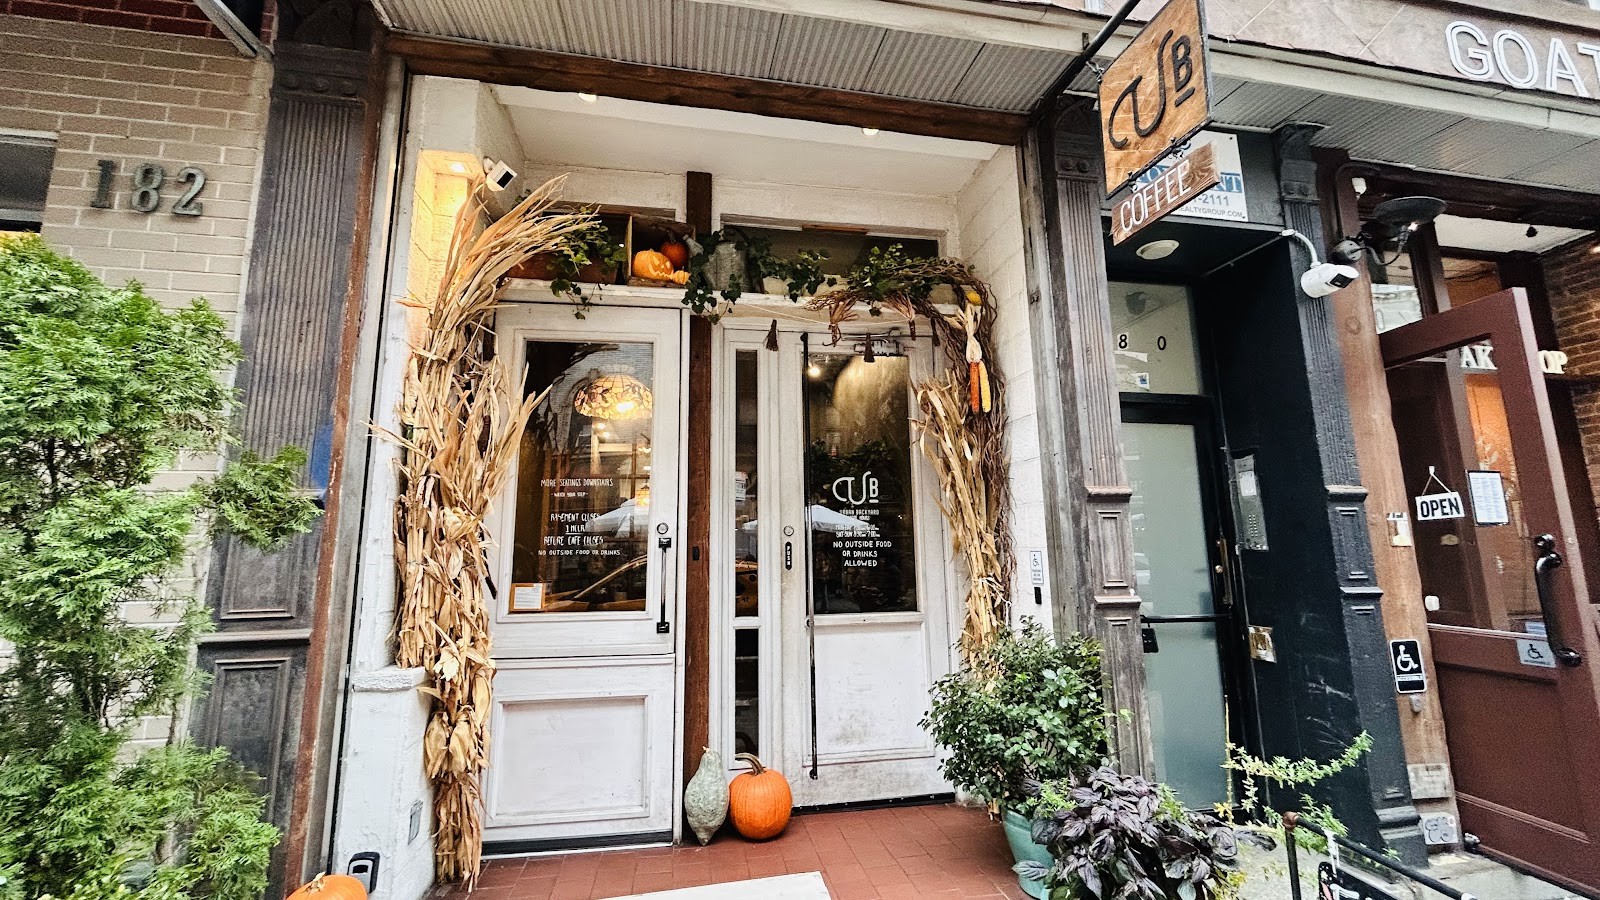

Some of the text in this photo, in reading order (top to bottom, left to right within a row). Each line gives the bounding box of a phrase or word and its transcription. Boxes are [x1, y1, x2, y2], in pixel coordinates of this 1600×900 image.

[1108, 29, 1195, 149] CUB
[90, 159, 205, 216] 182
[1120, 159, 1192, 232] COFFEE
[1460, 345, 1569, 374] AK OP
[540, 478, 614, 487] MORE SEATINGS DOWNSTAIRS
[832, 470, 879, 505] CUB
[1420, 497, 1461, 518] OPEN
[543, 536, 604, 546] BEFORE CAFE CLOSES
[853, 550, 878, 558] DRINKS
